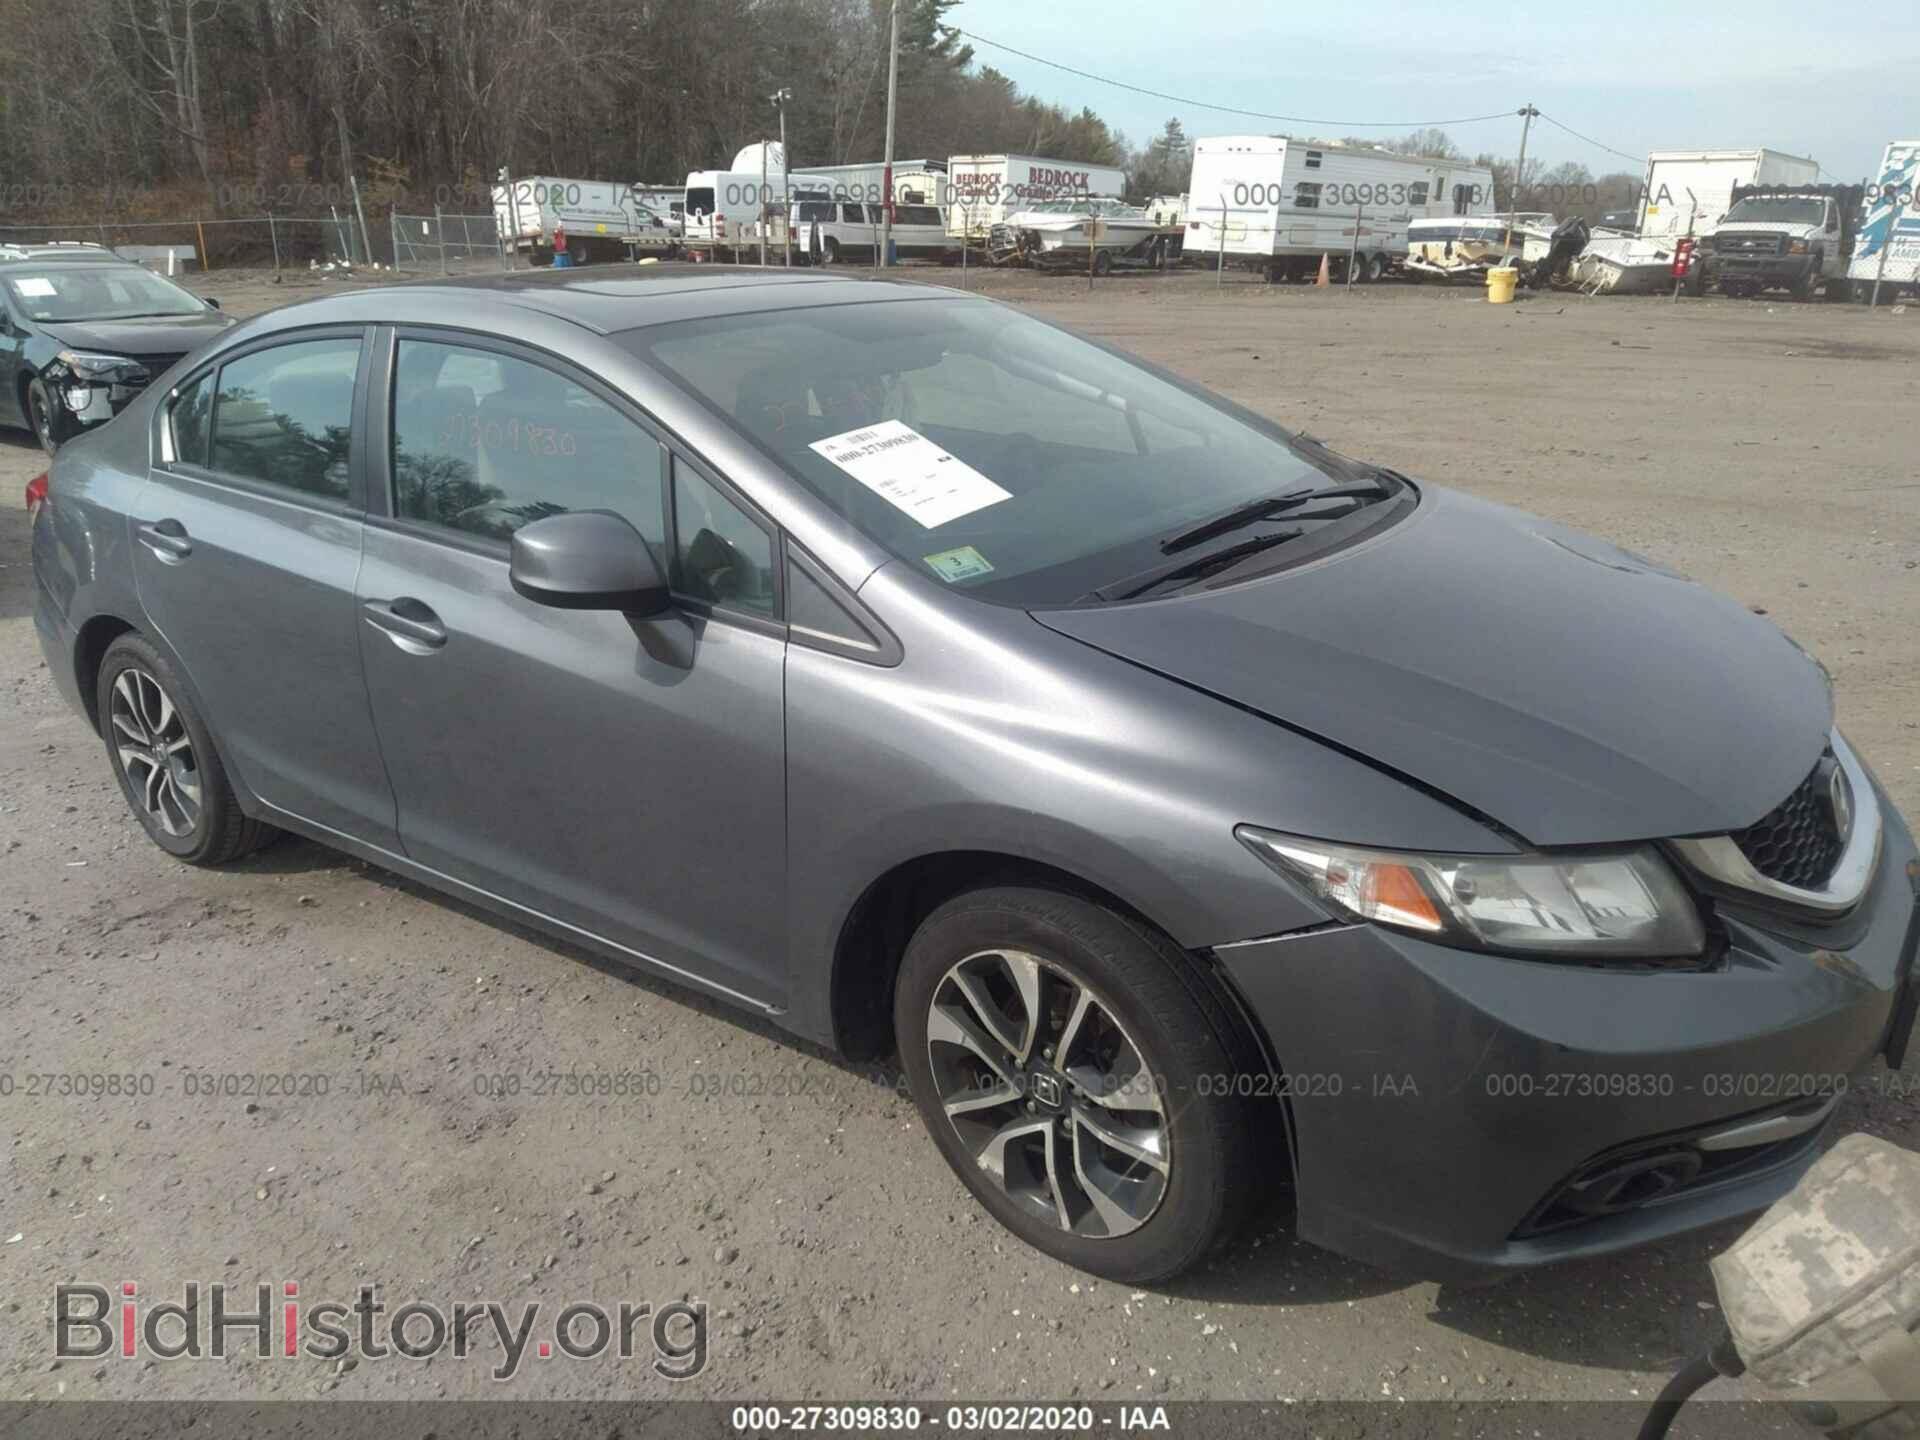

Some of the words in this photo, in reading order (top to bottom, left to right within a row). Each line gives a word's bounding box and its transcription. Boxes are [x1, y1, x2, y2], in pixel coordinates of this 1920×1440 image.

[956, 174, 1001, 185] BEDROCK
[1029, 167, 1089, 188] BEDROCK
[950, 556, 962, 567] 3
